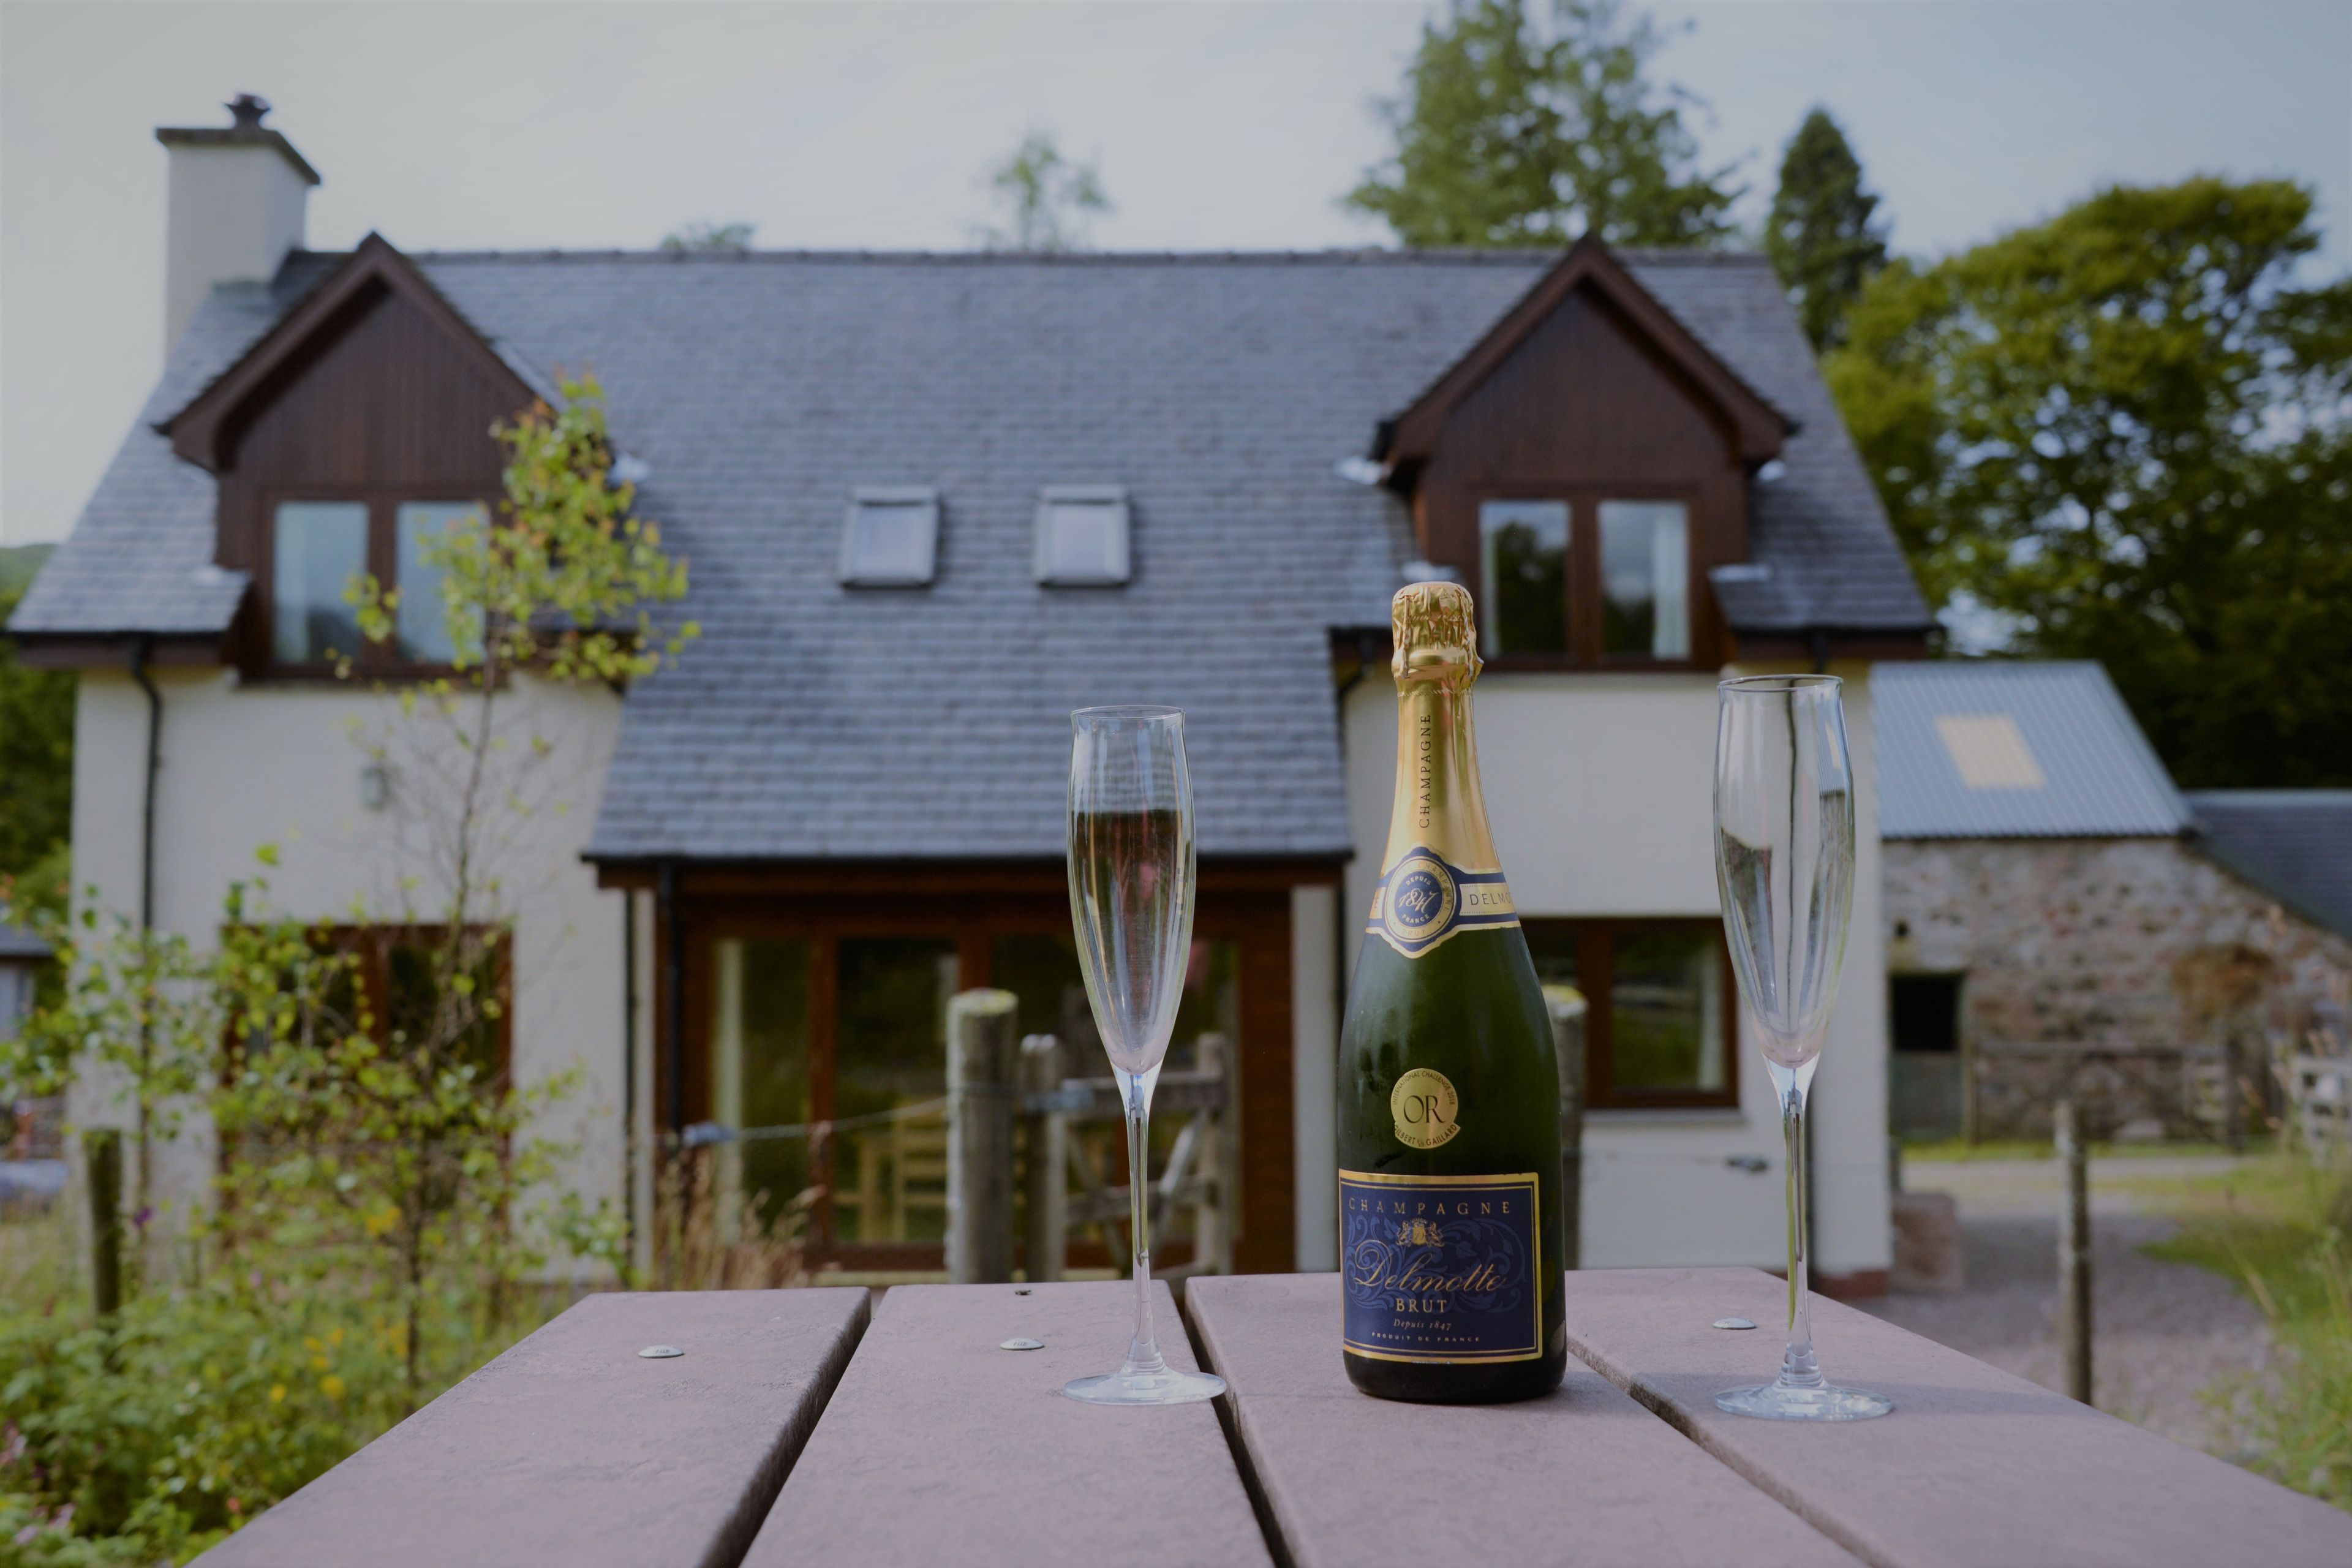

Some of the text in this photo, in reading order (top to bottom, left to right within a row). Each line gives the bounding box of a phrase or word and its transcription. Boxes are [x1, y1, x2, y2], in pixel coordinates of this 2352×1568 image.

[1419, 715, 1431, 829] CHAMPAGNE
[1406, 875, 1431, 886] DEPUIS
[1398, 888, 1439, 913] 1847
[1401, 913, 1430, 924] FRANCE
[1392, 1071, 1420, 1106] INTERNATIONAL
[1422, 1071, 1451, 1091] CHALLENGE
[1403, 1095, 1446, 1124] OR
[1394, 1125, 1415, 1145] GILBERT
[1425, 1124, 1457, 1146] GAILLARD
[1349, 1197, 1510, 1215] CHAMPAGNE
[1352, 1239, 1507, 1292] Delmotte
[1395, 1298, 1447, 1313] BRUT
[1393, 1319, 1452, 1331] Depuis 1847
[1371, 1332, 1411, 1341] PRODUIT
